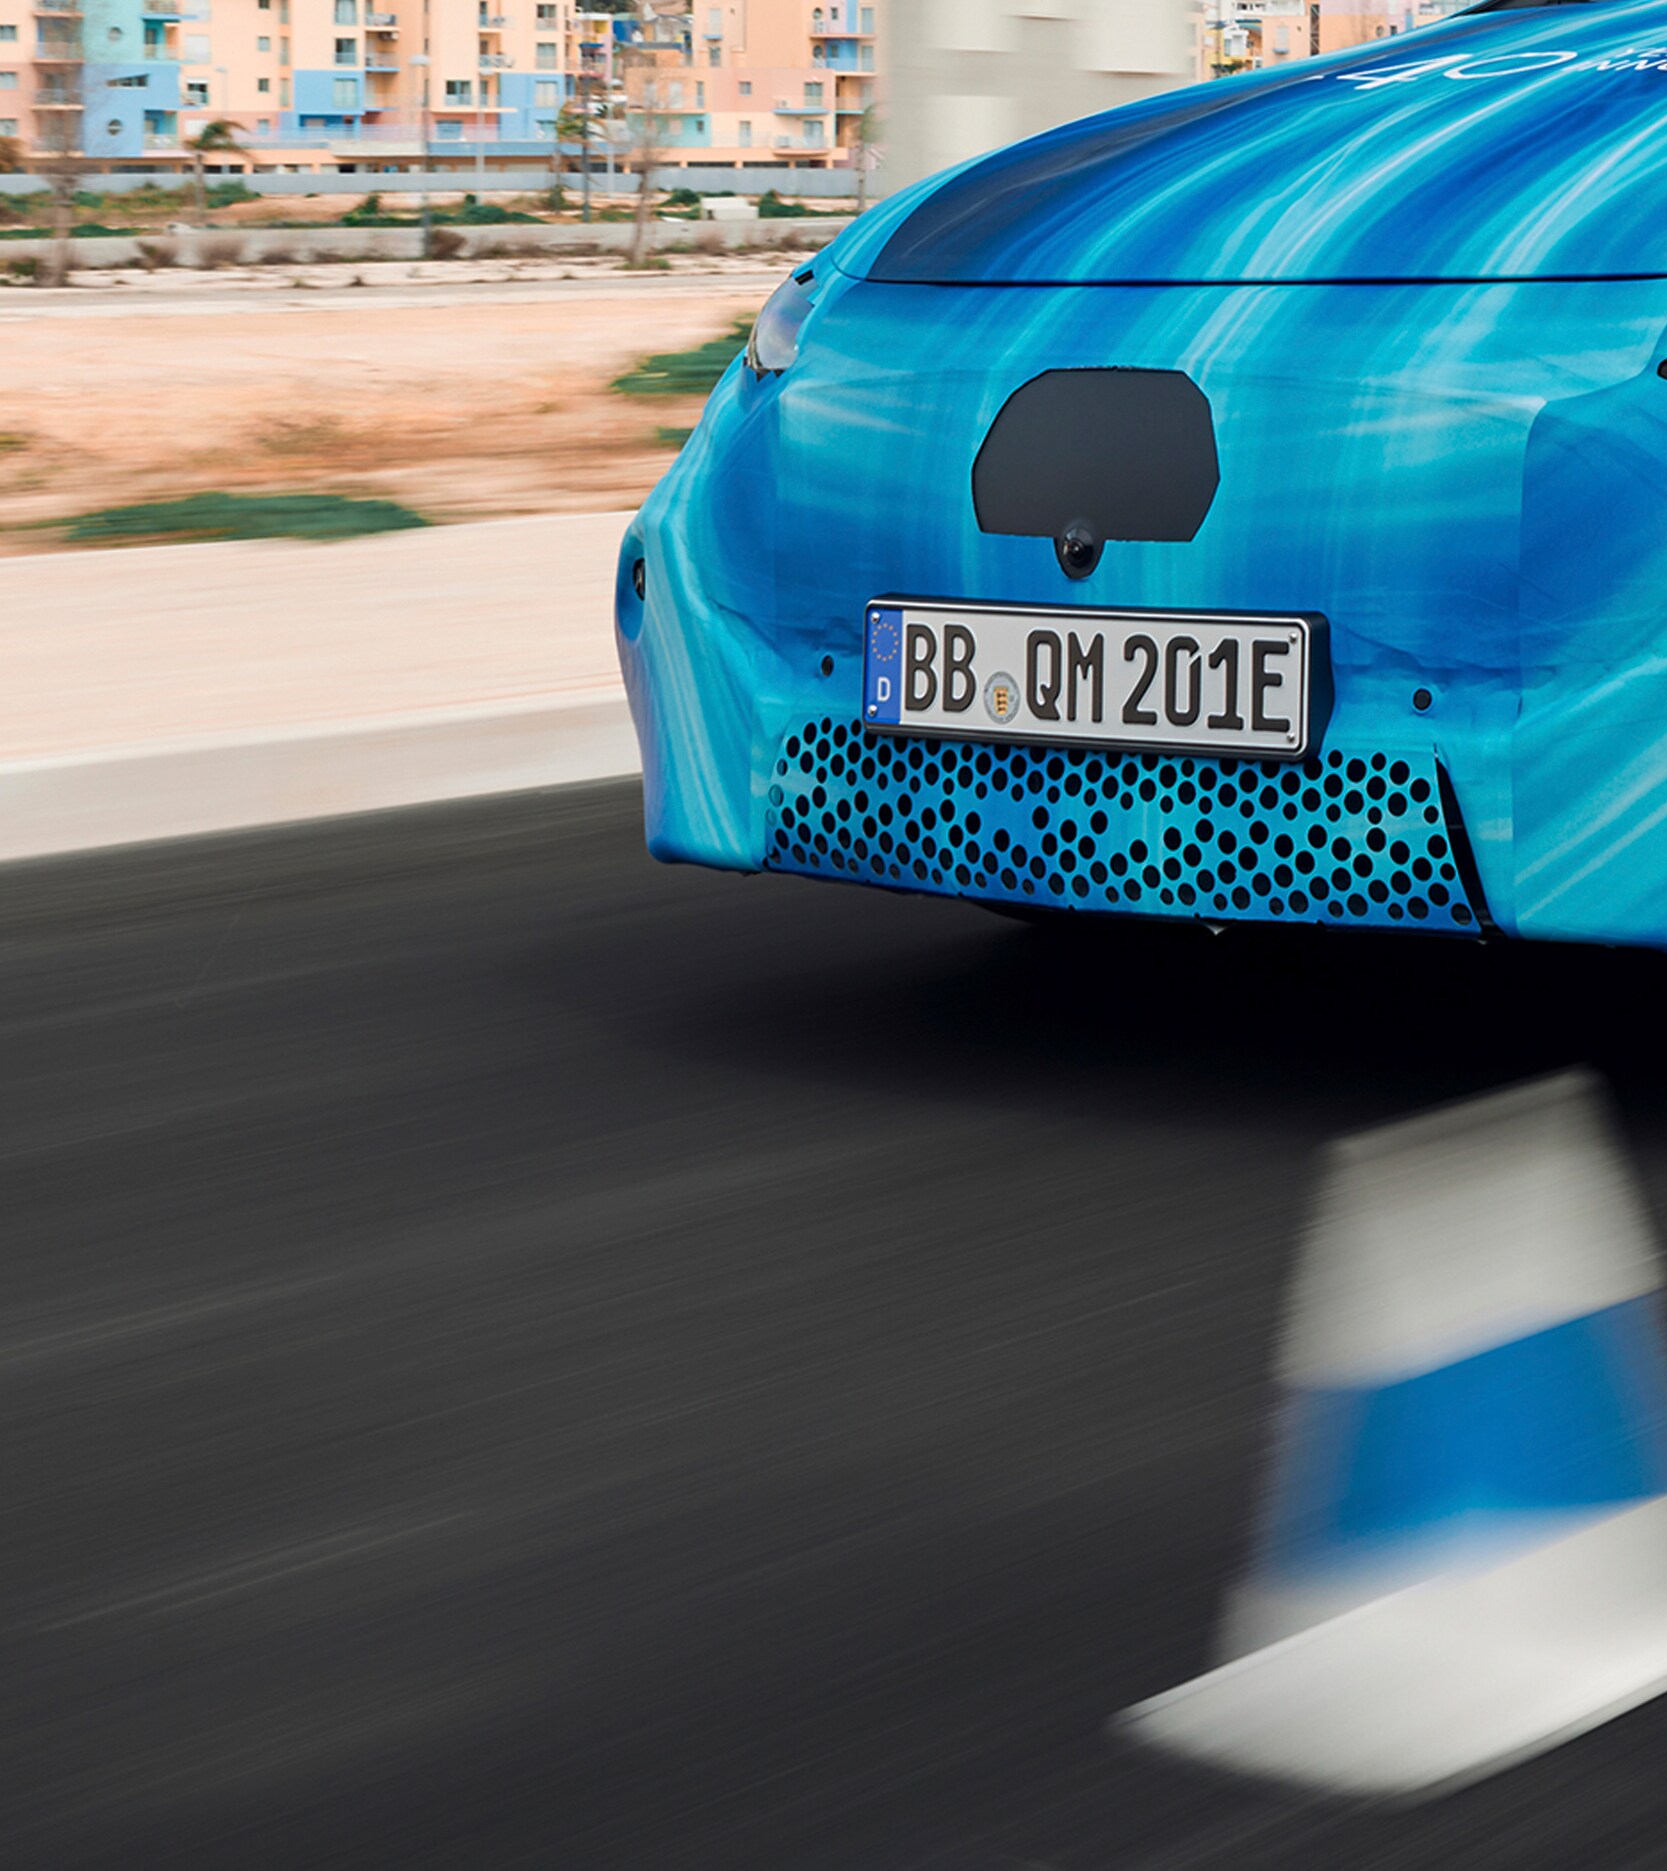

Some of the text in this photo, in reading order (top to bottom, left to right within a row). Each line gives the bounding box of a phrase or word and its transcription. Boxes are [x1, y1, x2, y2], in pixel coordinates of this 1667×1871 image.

[1306, 51, 1578, 90] 40
[877, 676, 891, 702] D
[904, 623, 1290, 732] BB QM 201E
